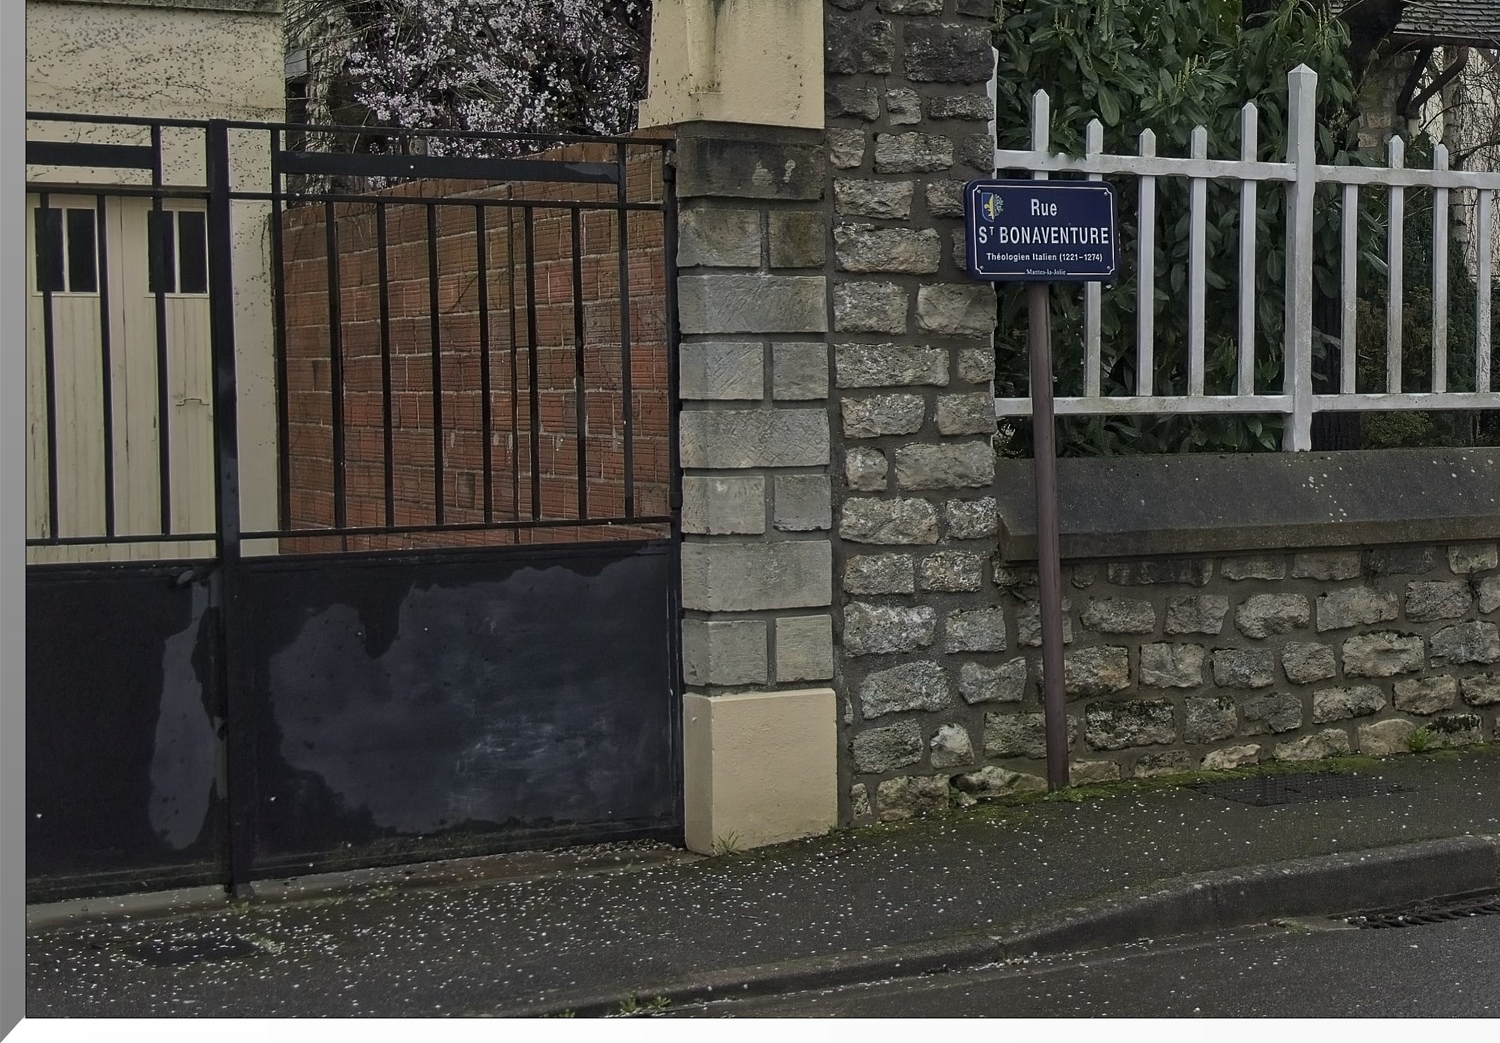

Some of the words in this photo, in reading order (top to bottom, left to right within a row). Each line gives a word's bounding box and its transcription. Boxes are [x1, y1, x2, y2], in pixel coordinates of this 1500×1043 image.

[1031, 198, 1058, 216] Rue
[1000, 226, 1109, 245] BONAVENTURE
[986, 252, 1030, 263] Théologien
[1032, 252, 1057, 261] Italien
